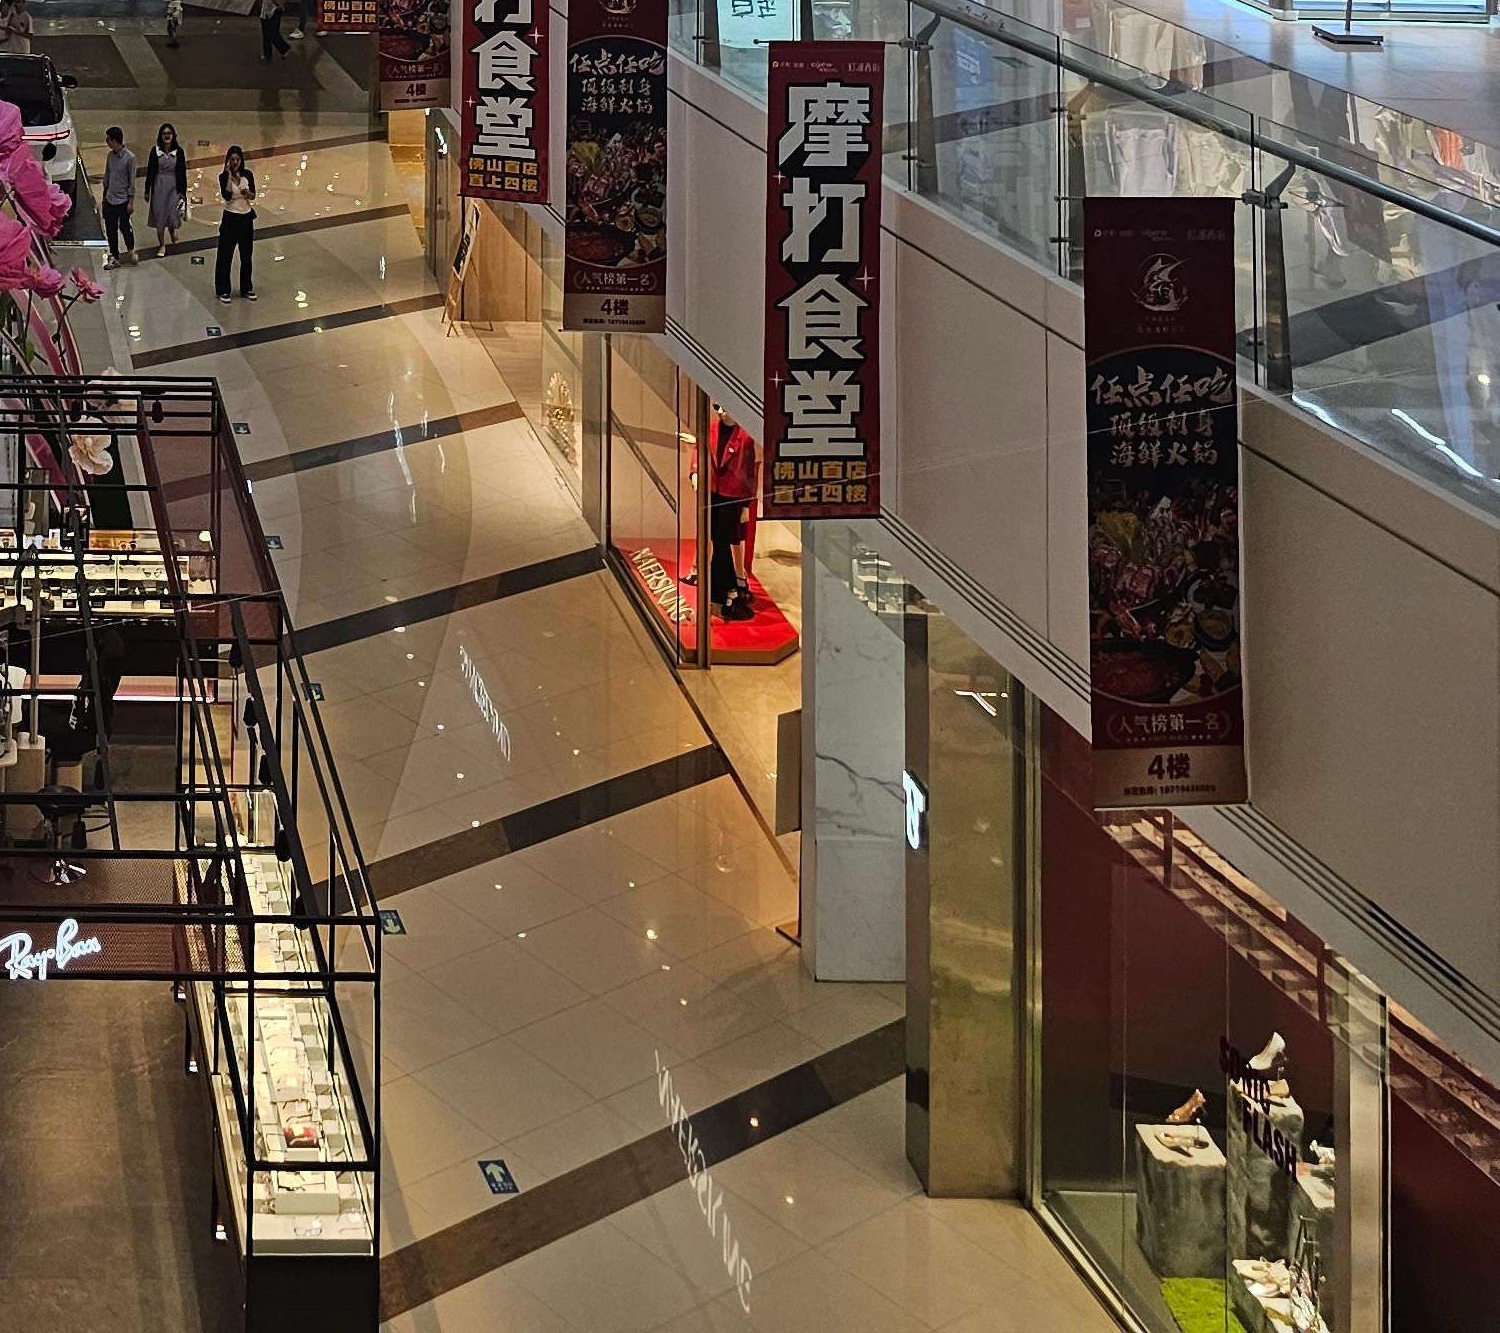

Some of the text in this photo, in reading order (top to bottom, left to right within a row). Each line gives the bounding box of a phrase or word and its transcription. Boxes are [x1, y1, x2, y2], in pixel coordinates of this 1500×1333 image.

[569, 48, 666, 76] 任点任吃
[581, 77, 653, 95] 顶级刺身
[581, 96, 654, 116] 海鲜火锅
[468, 157, 538, 177] 佛山首店
[468, 173, 538, 194] 直上四楼
[775, 82, 870, 457] 摩打食堂
[600, 298, 629, 316] 4楼
[1089, 364, 1234, 409] 任点任吃
[1108, 409, 1215, 437] 顶级刺身
[1108, 439, 1219, 469] 海鲜火锅
[773, 460, 868, 481] 佛山首店
[773, 484, 868, 505] 直上四楼
[1117, 711, 1220, 734] 人气榜第一名
[1147, 752, 1191, 781] 4楼
